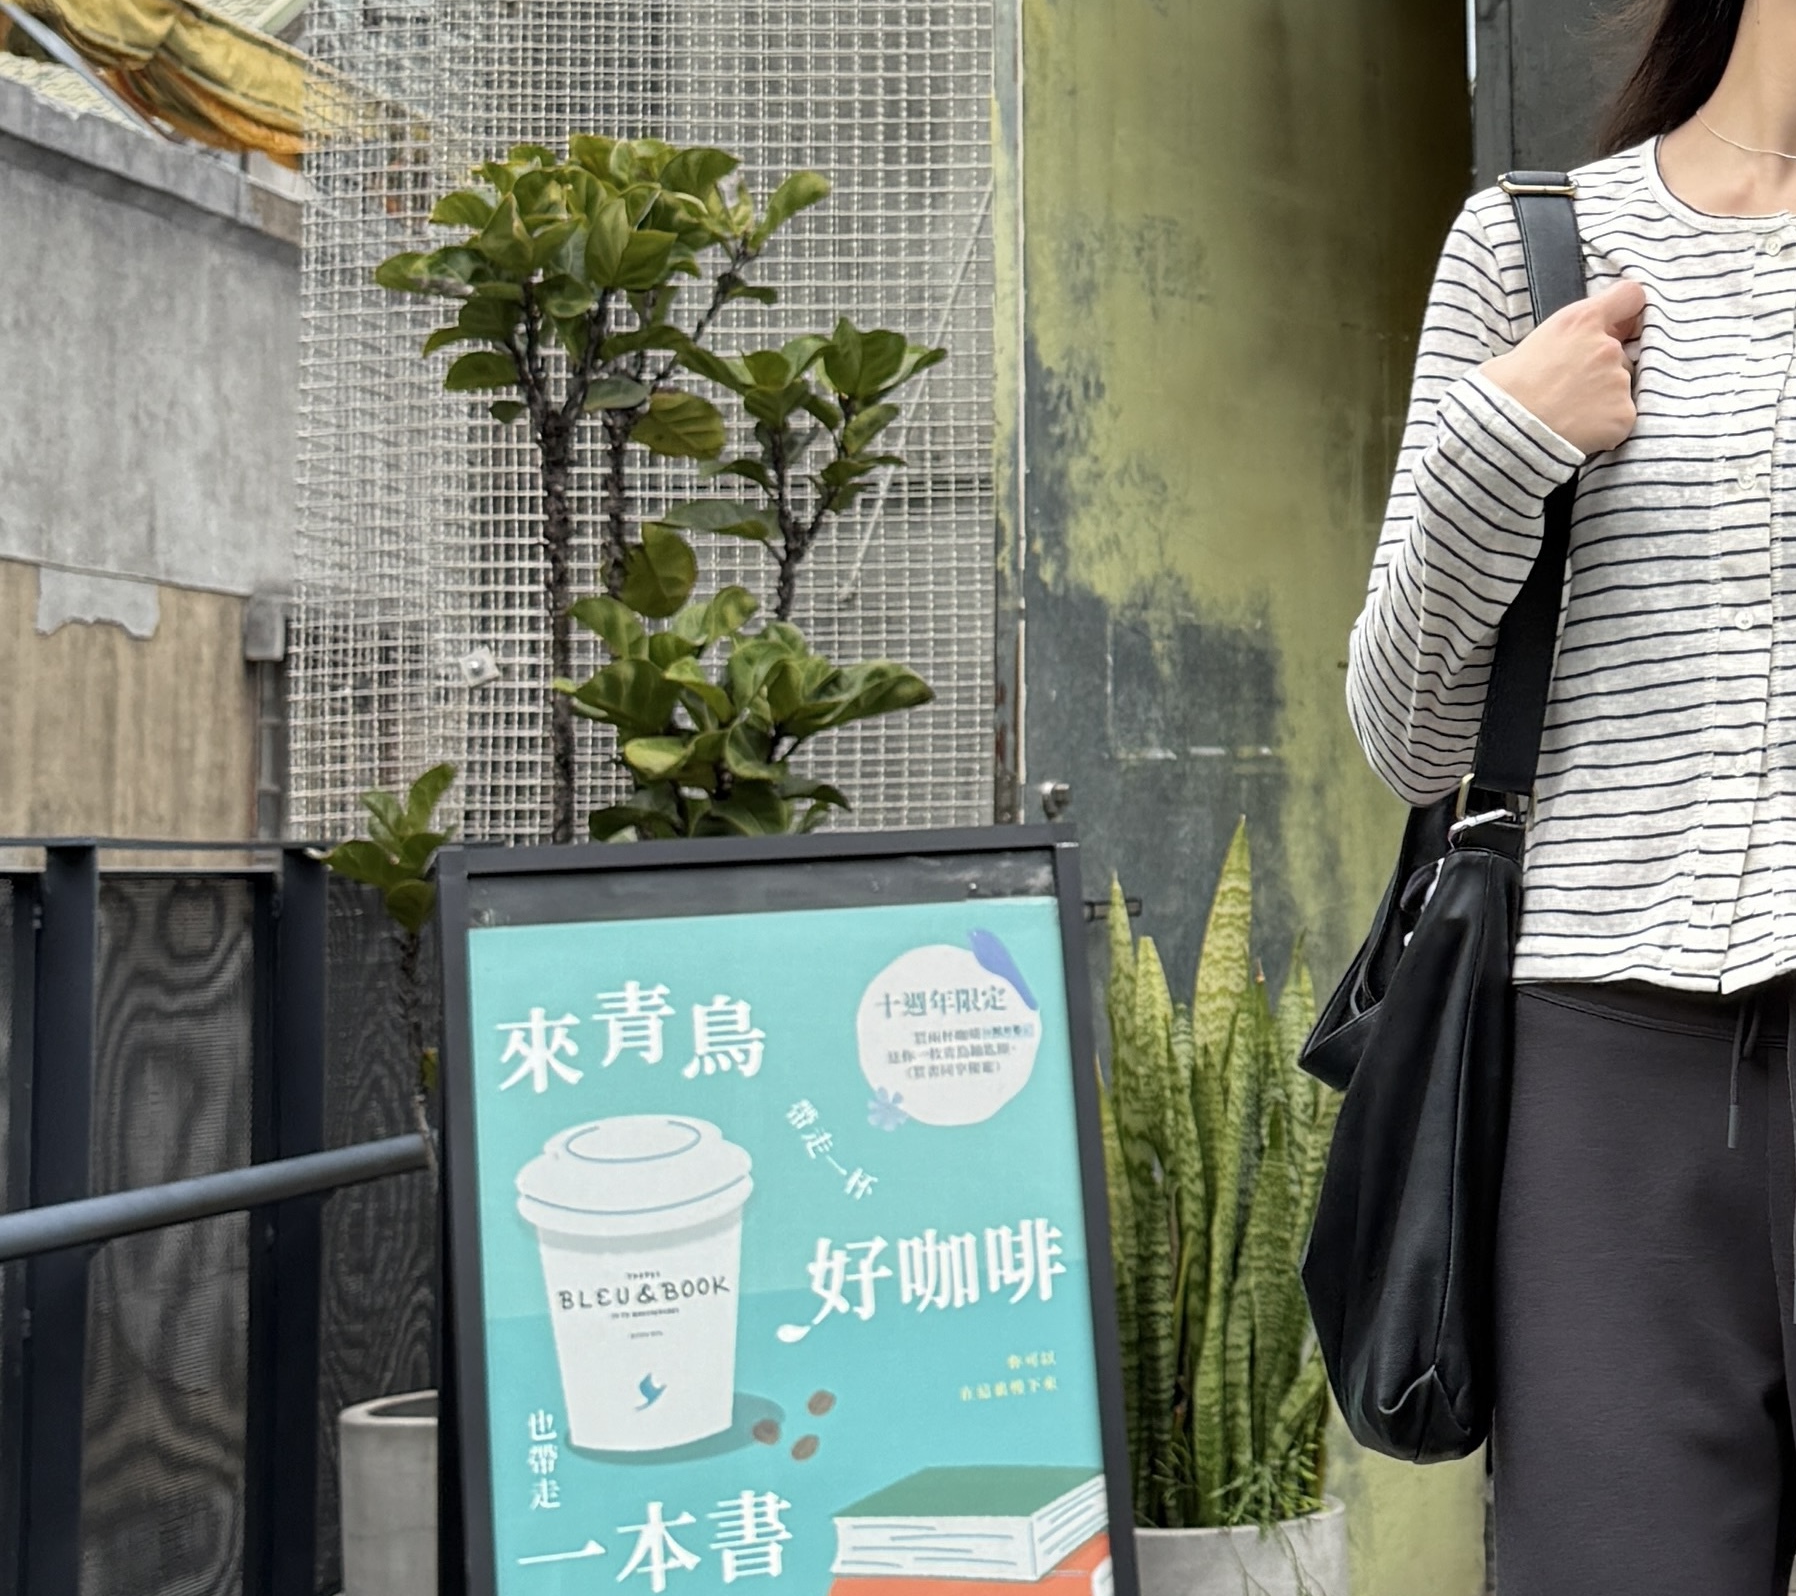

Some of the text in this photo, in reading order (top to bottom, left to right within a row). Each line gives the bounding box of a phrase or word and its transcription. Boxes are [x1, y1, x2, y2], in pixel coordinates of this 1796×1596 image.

[495, 980, 766, 1094] 來青鳥
[875, 985, 1008, 1019] 十週年限定
[784, 1098, 879, 1201] 帶走一杯
[804, 1217, 1068, 1322] 好咖啡
[528, 1409, 561, 1509] 也帶走
[517, 1490, 793, 1594] 一本書
